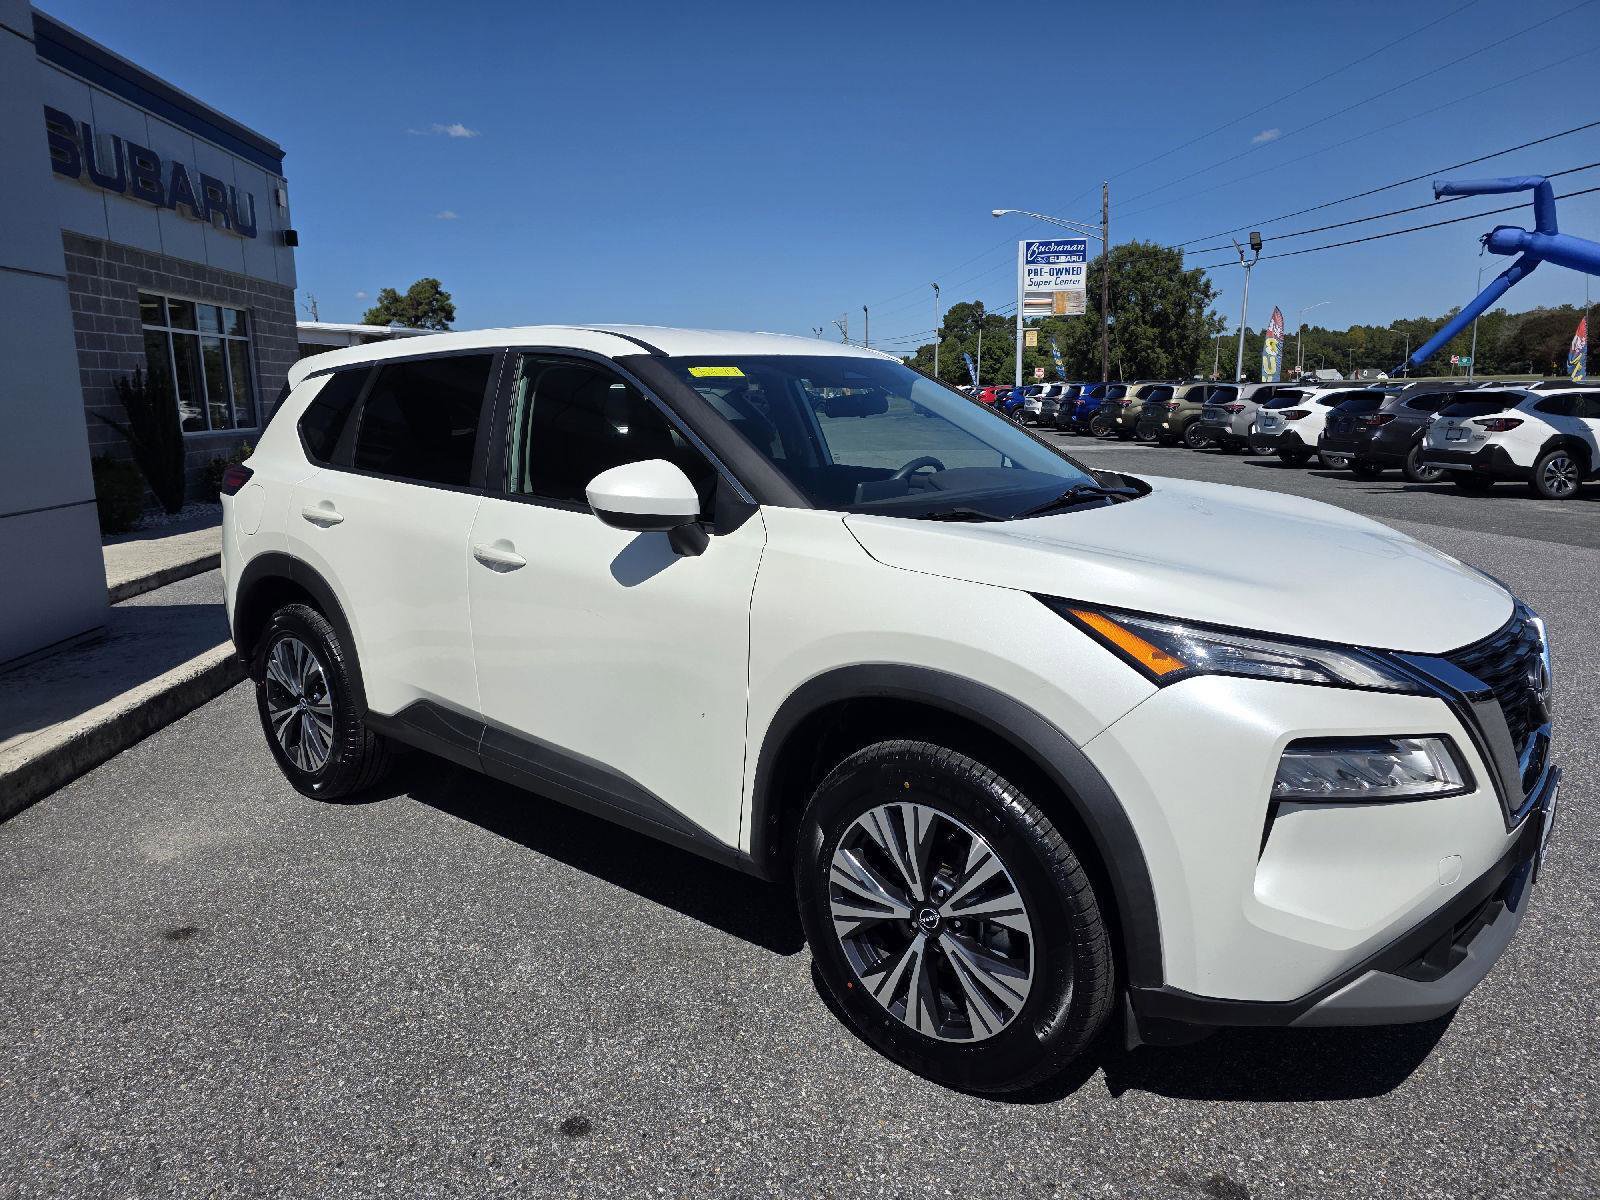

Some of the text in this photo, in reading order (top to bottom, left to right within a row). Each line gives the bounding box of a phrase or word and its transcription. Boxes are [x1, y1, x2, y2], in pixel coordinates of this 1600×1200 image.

[43, 104, 257, 239] SUBARU
[1027, 242, 1085, 261] Buchanan
[1050, 255, 1082, 263] SUBARU
[1028, 267, 1082, 277] PRE-OWNED
[1028, 276, 1080, 288] Super Center
